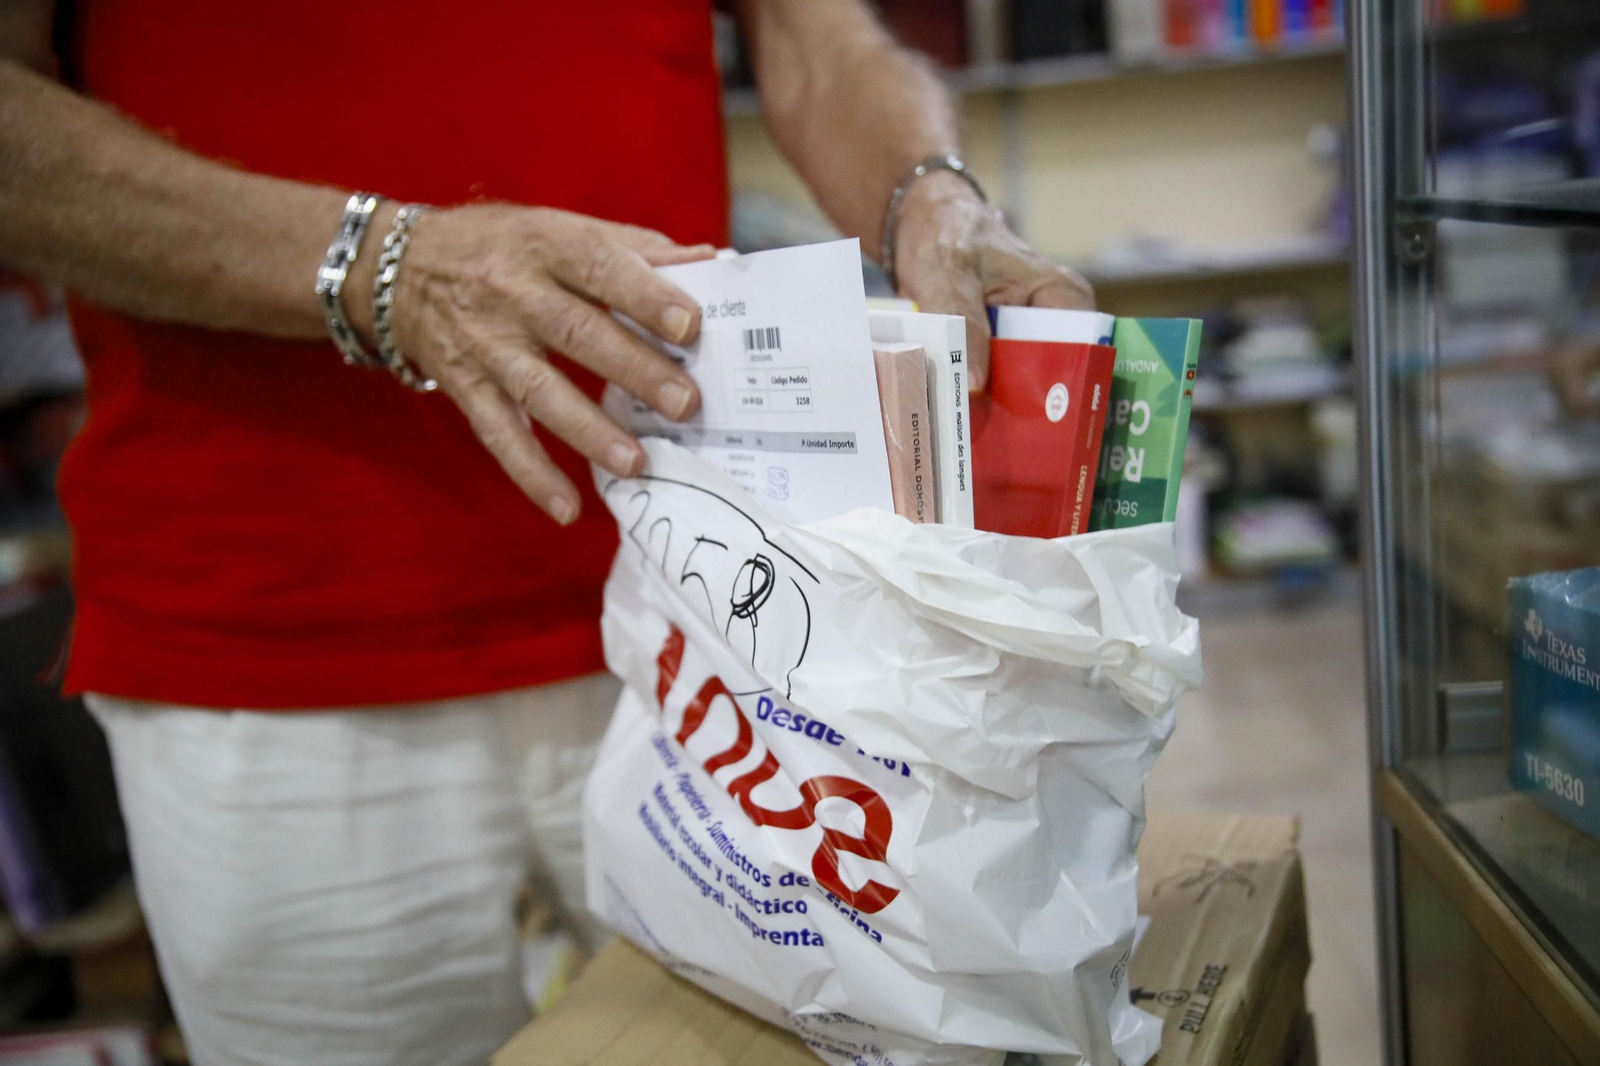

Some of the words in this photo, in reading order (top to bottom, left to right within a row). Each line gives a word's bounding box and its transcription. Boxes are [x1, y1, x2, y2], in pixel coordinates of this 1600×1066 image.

[789, 375, 808, 384] Pedido
[796, 396, 810, 405] 3258
[829, 440, 855, 449] Importe
[911, 412, 921, 472] EDITORIAL
[955, 411, 963, 442] maison
[956, 460, 966, 492] langues
[1073, 465, 1088, 503] LENGUA
[1545, 629, 1586, 665] TEXAS
[1525, 752, 1584, 806] TI-5630
[706, 821, 771, 888] Suministros
[779, 871, 810, 887] de
[735, 902, 825, 947] Imprenta
